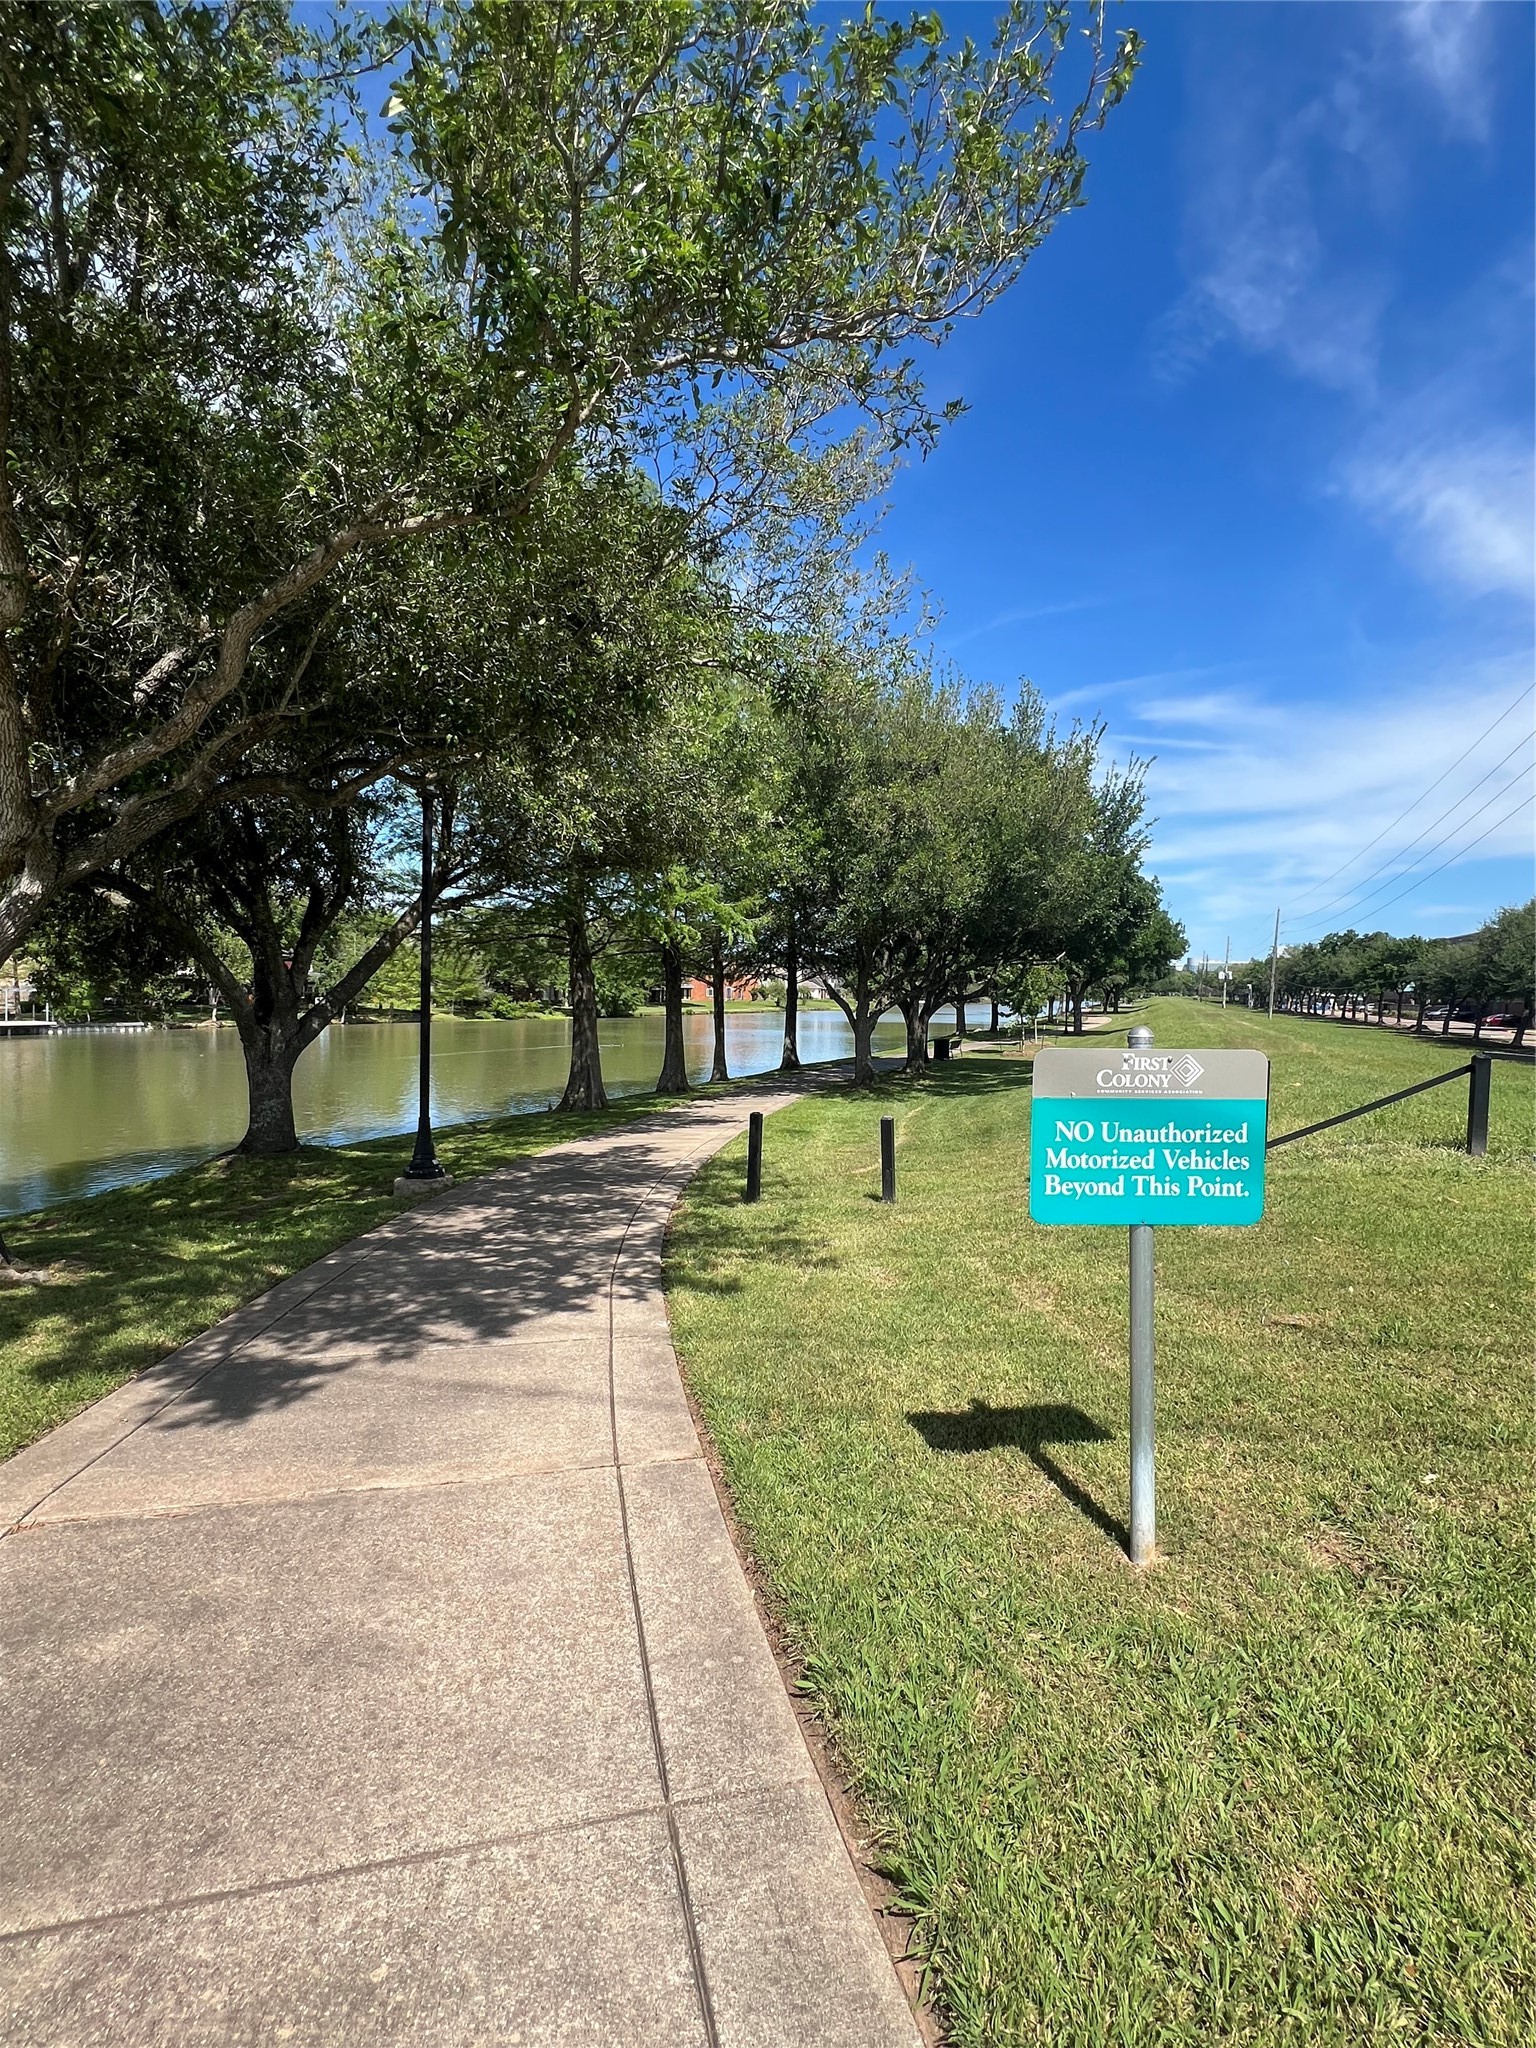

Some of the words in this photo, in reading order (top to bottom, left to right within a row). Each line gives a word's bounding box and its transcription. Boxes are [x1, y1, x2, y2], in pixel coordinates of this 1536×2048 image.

[1121, 1052, 1173, 1071] FIRST
[1096, 1069, 1172, 1087] COLONY
[1055, 1121, 1094, 1143] NO
[1101, 1121, 1248, 1143] Unauthorized
[1045, 1148, 1155, 1170] Motorized
[1162, 1149, 1250, 1171] Vehicles
[1044, 1174, 1125, 1200] Beyond
[1131, 1175, 1180, 1196] This
[1187, 1175, 1250, 1197] Point.
